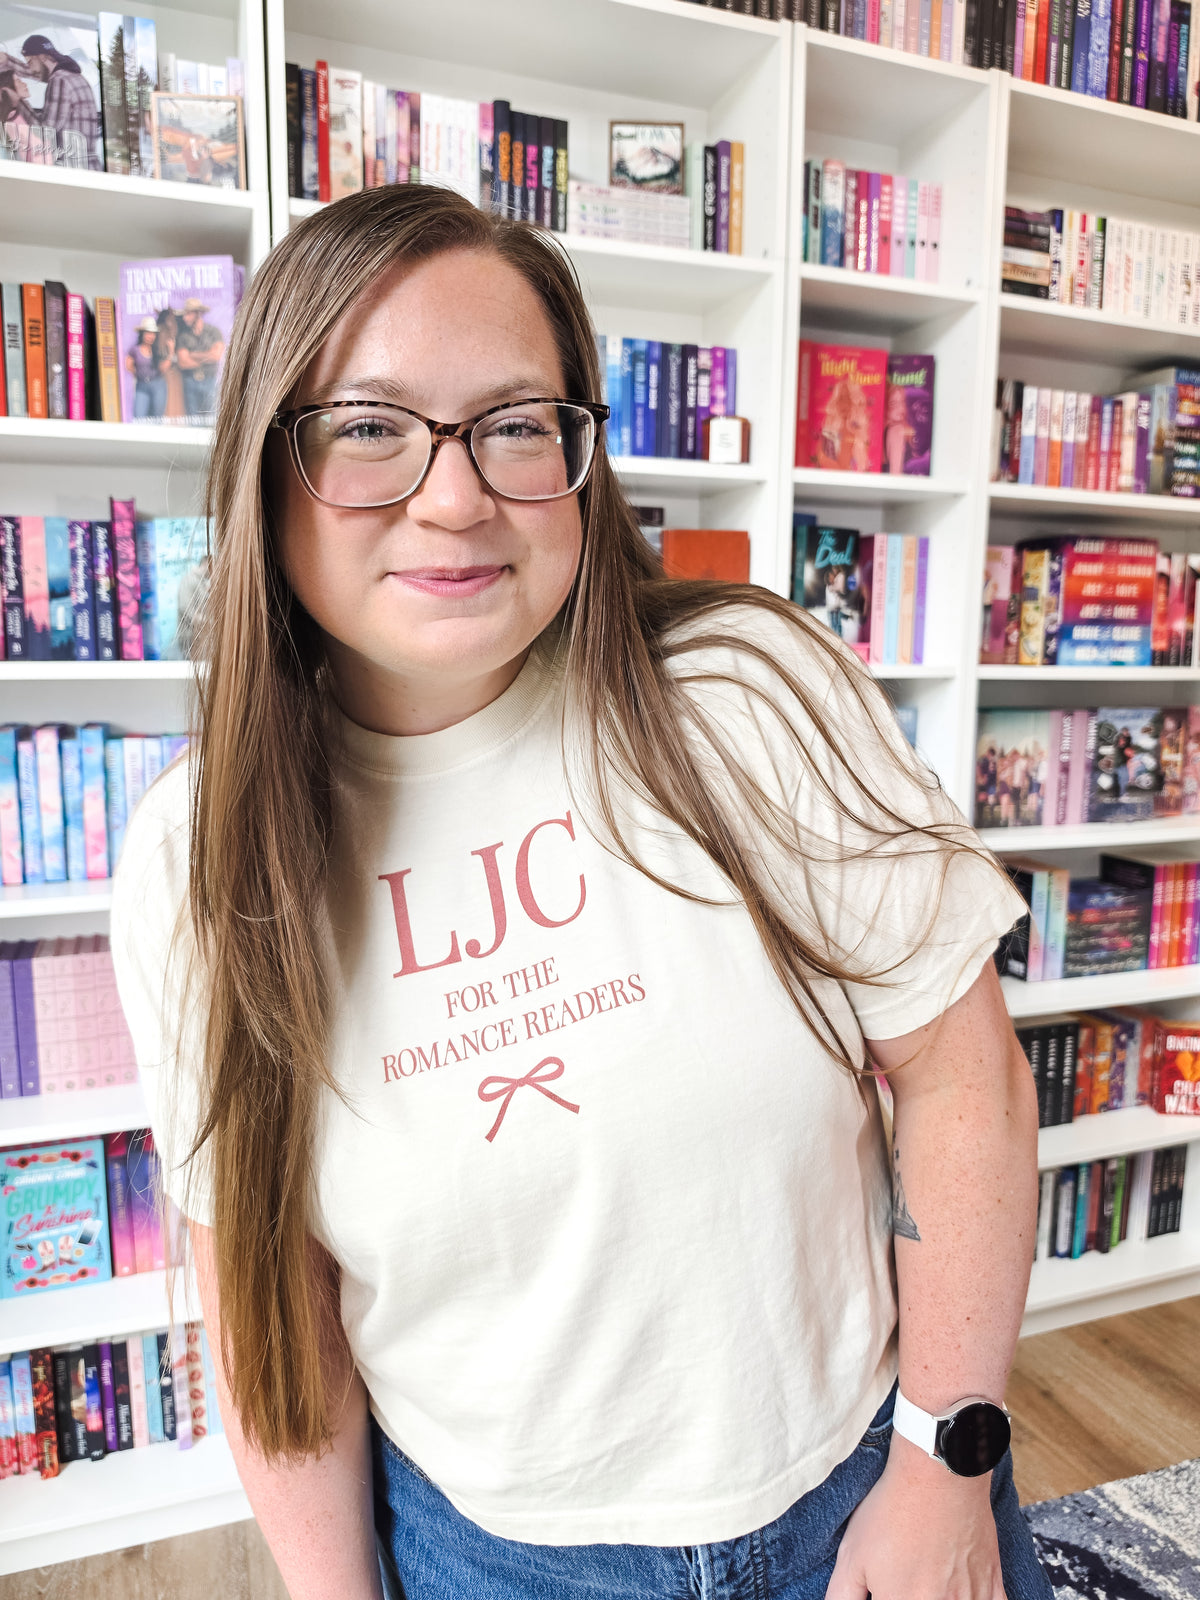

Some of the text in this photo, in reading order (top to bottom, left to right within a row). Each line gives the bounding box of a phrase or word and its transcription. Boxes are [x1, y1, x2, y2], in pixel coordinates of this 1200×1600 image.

[1178, 24, 1189, 73] RESONANCE
[498, 131, 511, 182] COACH
[512, 141, 524, 187] COACH
[526, 144, 538, 189] BLITZ
[542, 145, 554, 189] RALLY
[556, 148, 567, 193] MERIT
[126, 264, 225, 291] TRAINING THE
[69, 296, 83, 334] HOLDING
[1136, 400, 1151, 430] PLAY
[814, 536, 854, 569] Deal
[818, 529, 836, 546] The
[1060, 715, 1072, 752] SAVING
[378, 810, 586, 978] LJC
[444, 957, 560, 1019] FOR THE
[381, 973, 646, 1084] ROMANCE READERS
[6, 1176, 98, 1217] GRUMPY
[14, 1208, 93, 1241] Sunshine
